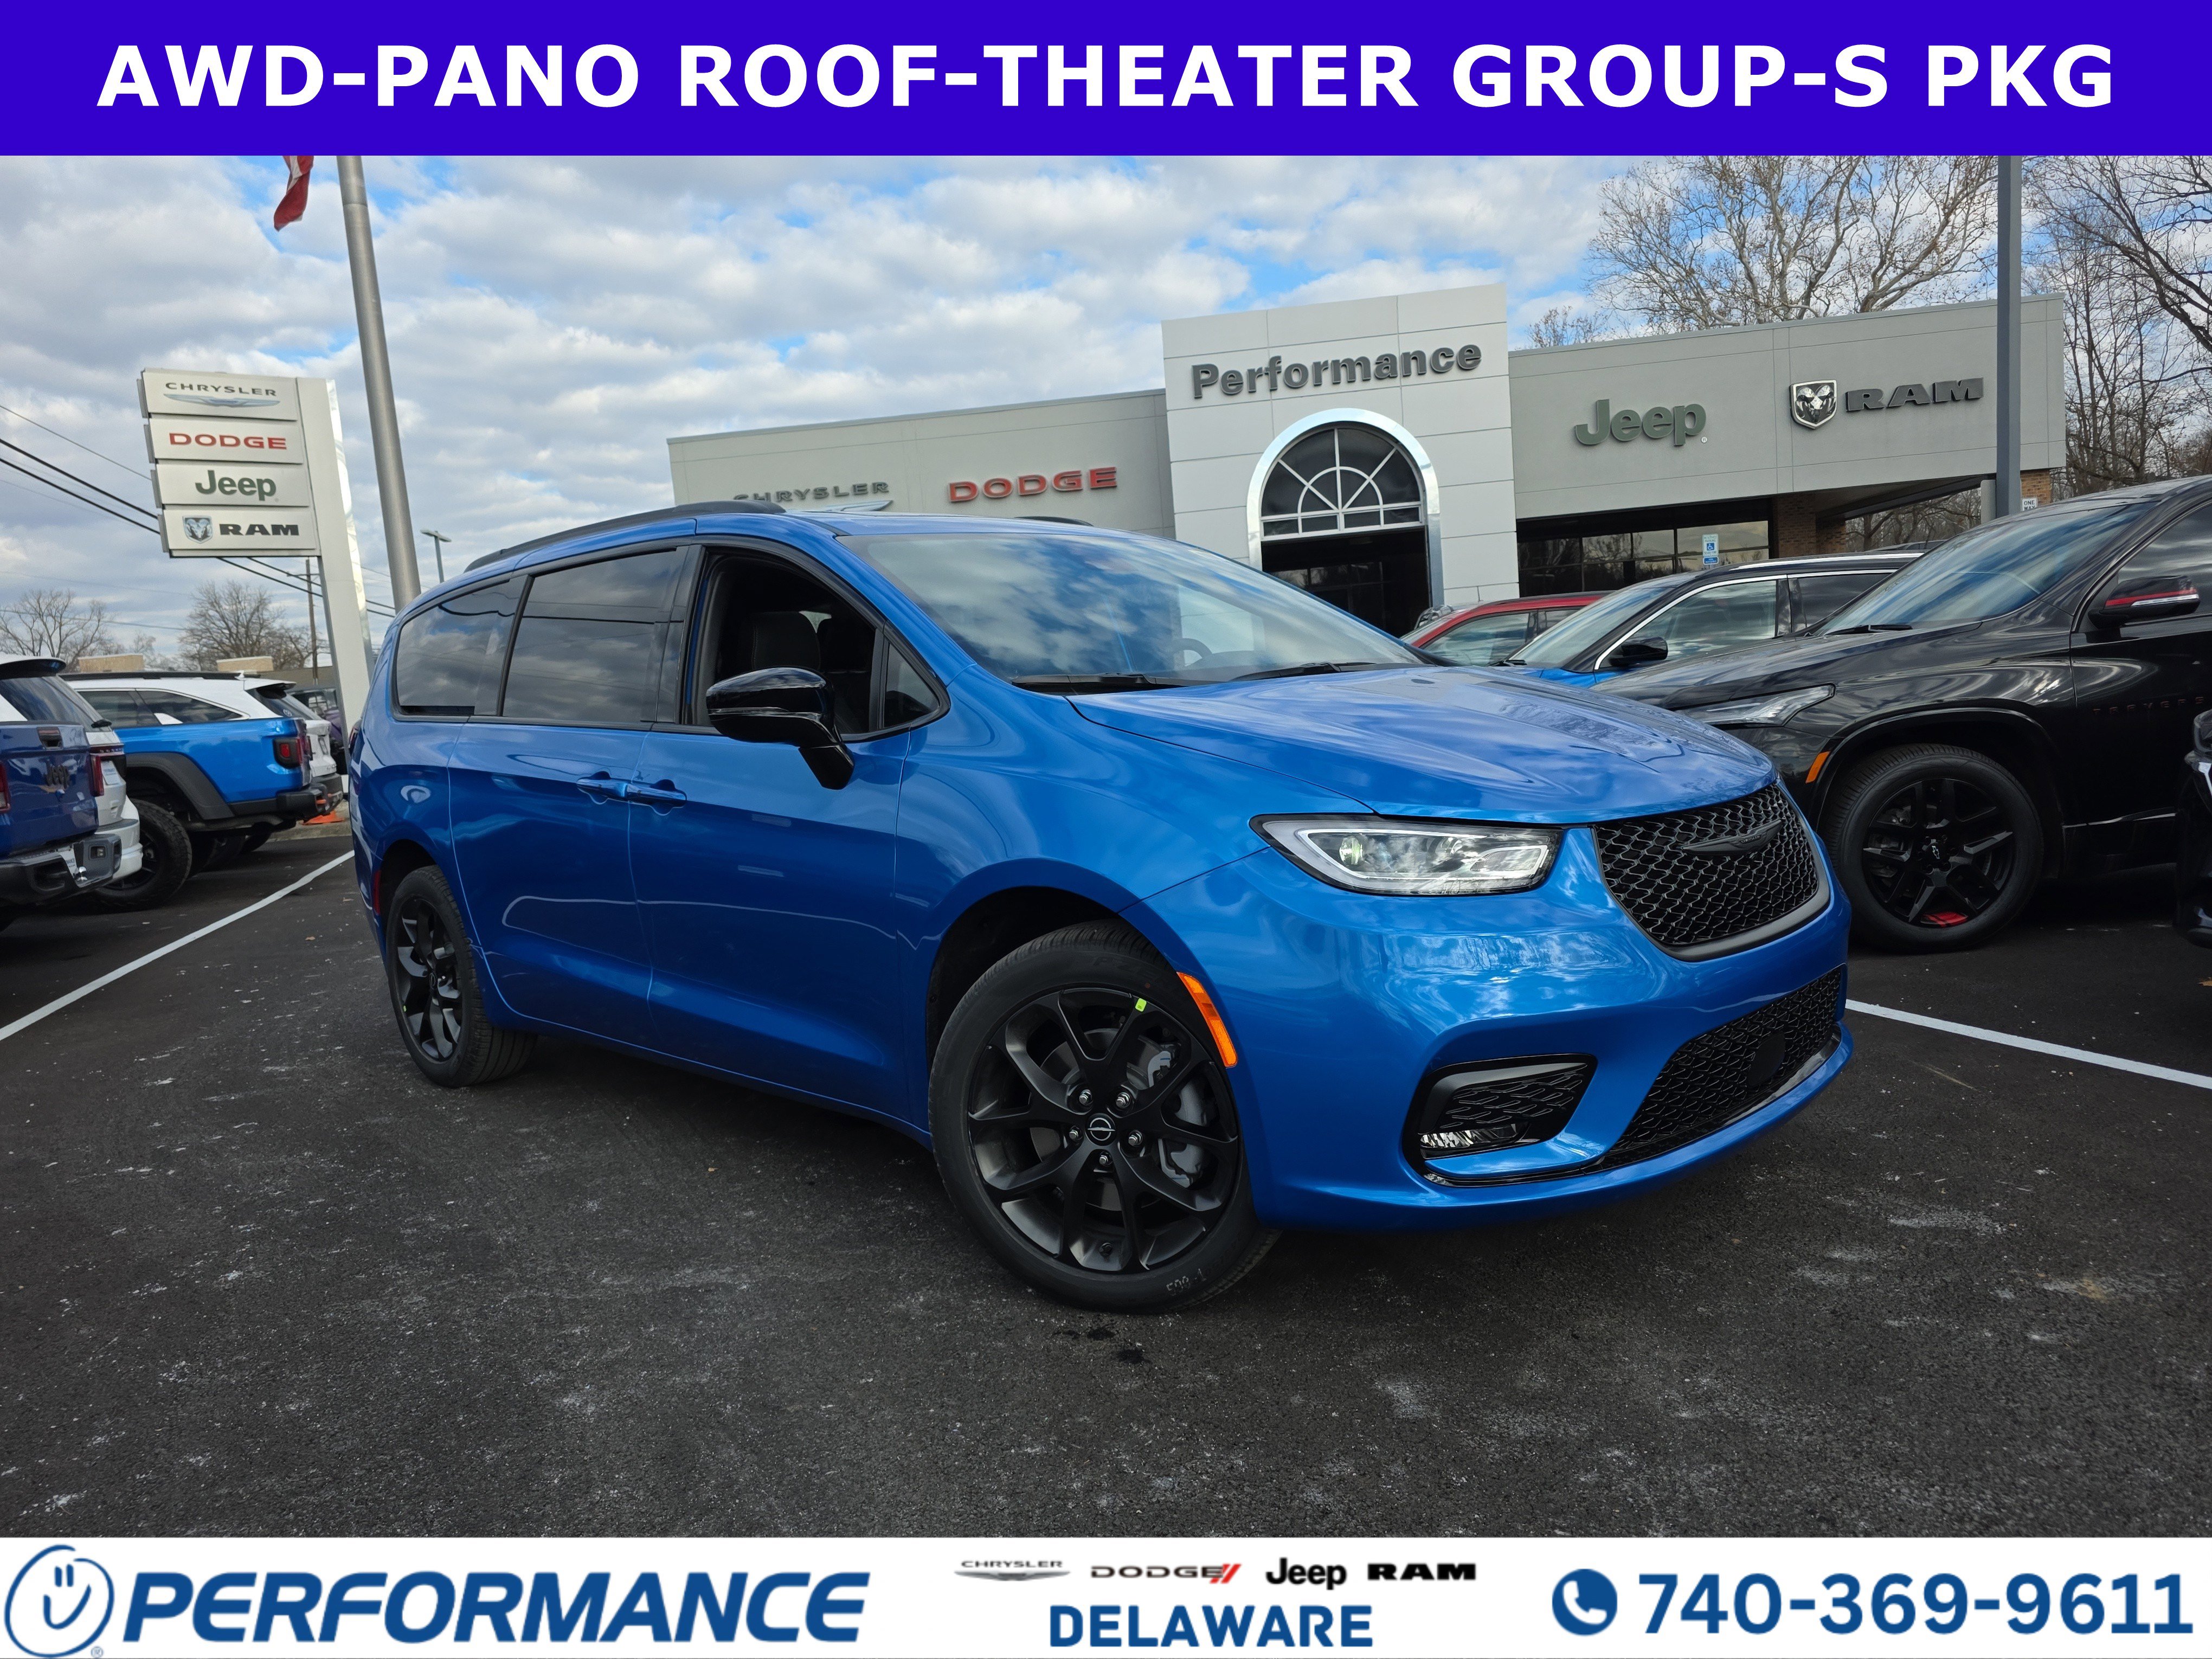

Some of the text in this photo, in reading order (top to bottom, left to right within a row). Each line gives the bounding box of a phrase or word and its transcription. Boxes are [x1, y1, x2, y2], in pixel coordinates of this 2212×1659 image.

[1192, 344, 1482, 398] Performance
[165, 382, 277, 396] CHRYSLER
[1846, 377, 1984, 413] RAM
[1574, 398, 1707, 446] Jeep
[169, 433, 287, 449] DODGE
[195, 470, 276, 501] Jeep
[948, 467, 1117, 502] DODGE
[220, 524, 299, 536] RAM
